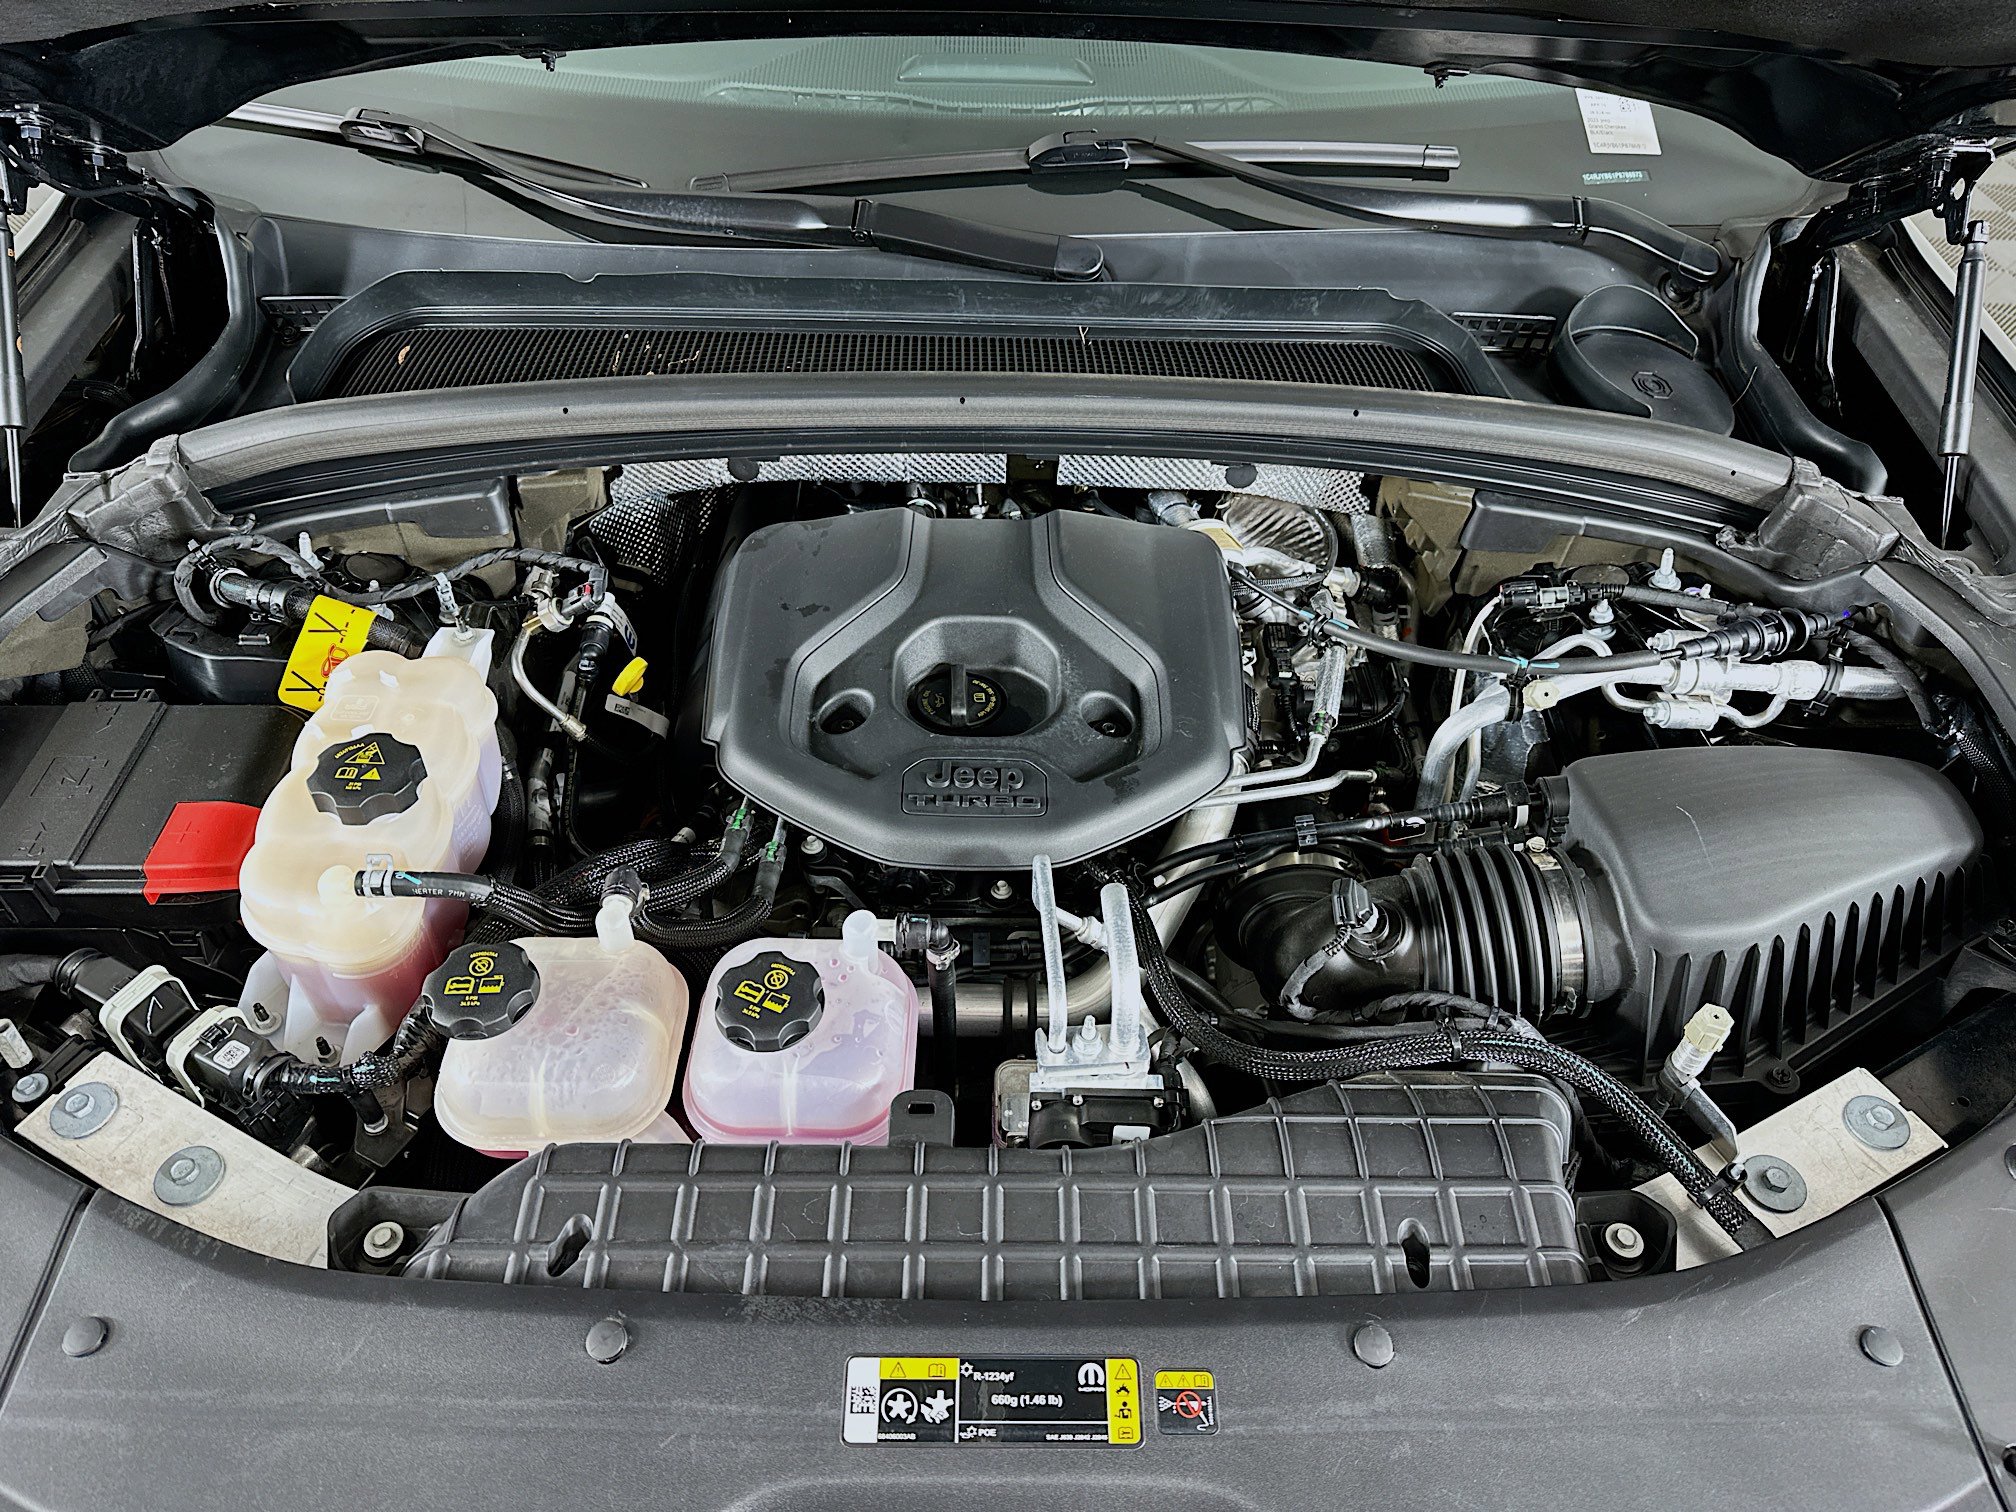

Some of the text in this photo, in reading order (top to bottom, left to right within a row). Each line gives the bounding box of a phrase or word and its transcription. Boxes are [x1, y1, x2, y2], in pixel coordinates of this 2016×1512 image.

[926, 761, 1024, 794] Jeep
[908, 794, 1041, 809] TURBO
[448, 889, 465, 898] 7MM
[973, 1371, 1015, 1382] R-1234yf
[991, 1394, 1063, 1408] 660g (1.46 lb)
[978, 1428, 997, 1437] POE
[1045, 1433, 1059, 1441] SAE
